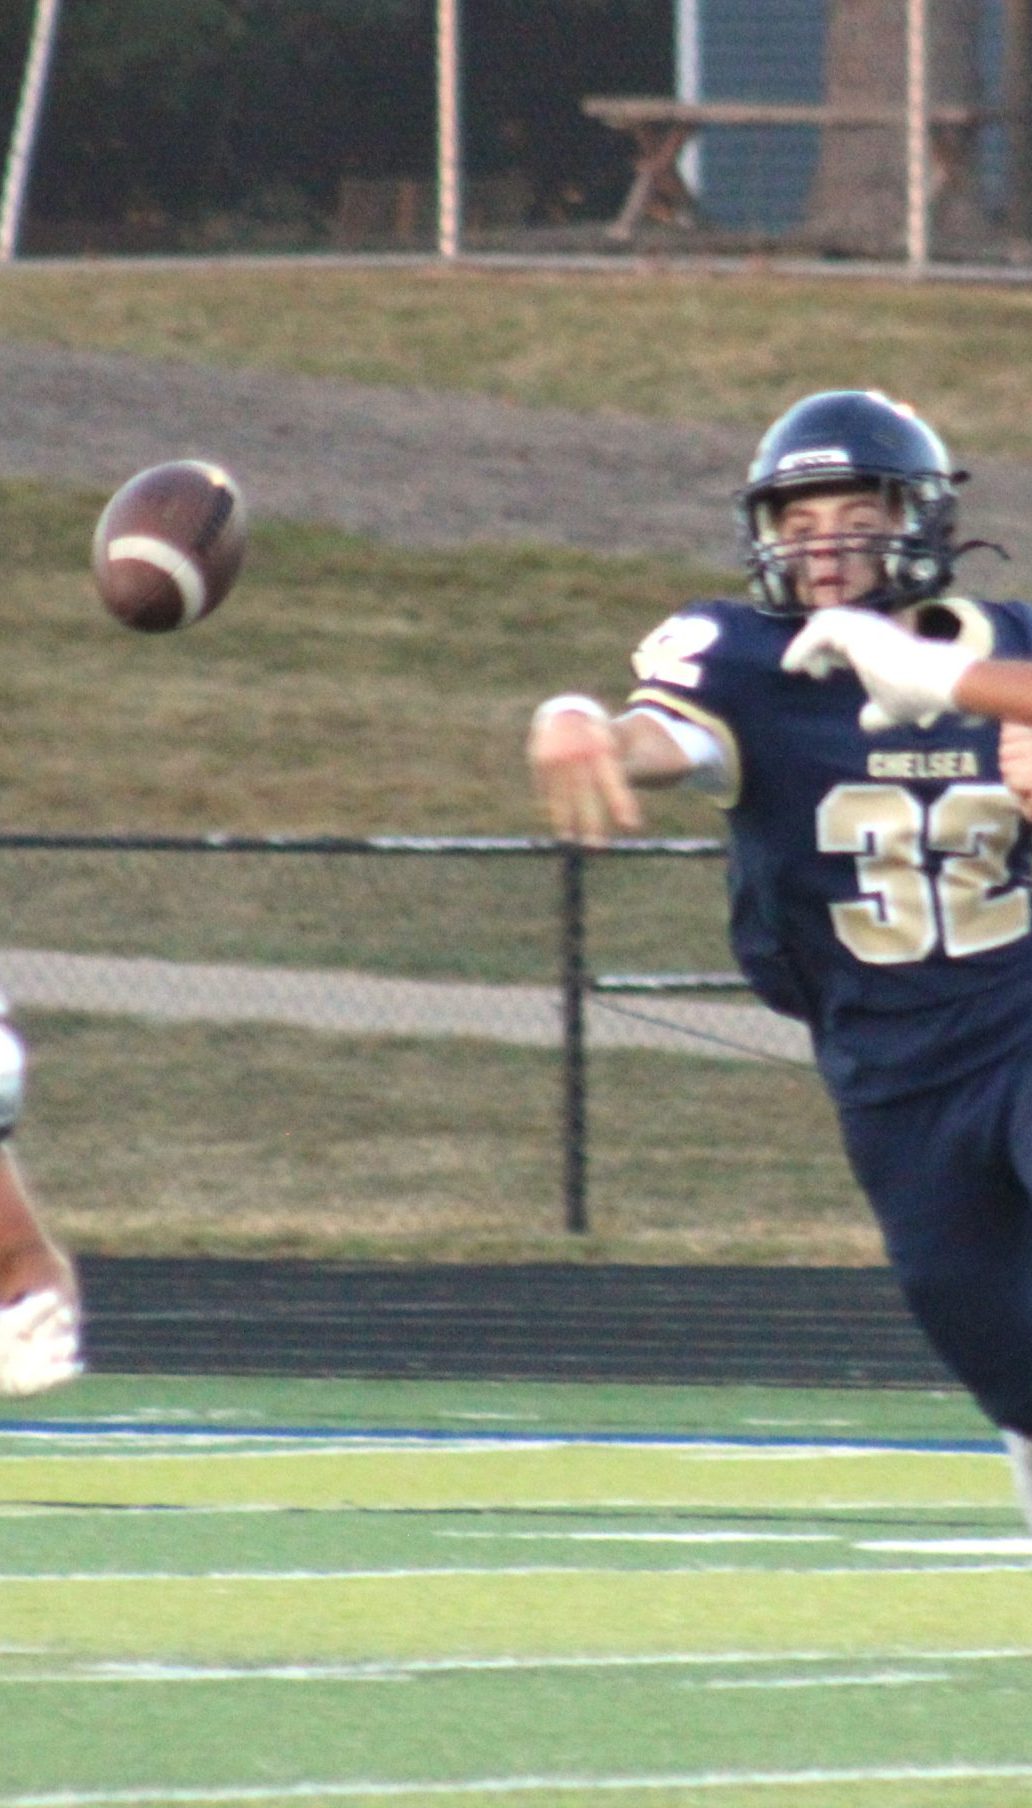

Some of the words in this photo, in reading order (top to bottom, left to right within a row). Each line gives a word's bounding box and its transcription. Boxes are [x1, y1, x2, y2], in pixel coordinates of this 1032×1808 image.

[631, 615, 720, 689] 2
[867, 750, 978, 778] CHELSEA
[815, 783, 1032, 965] 32
